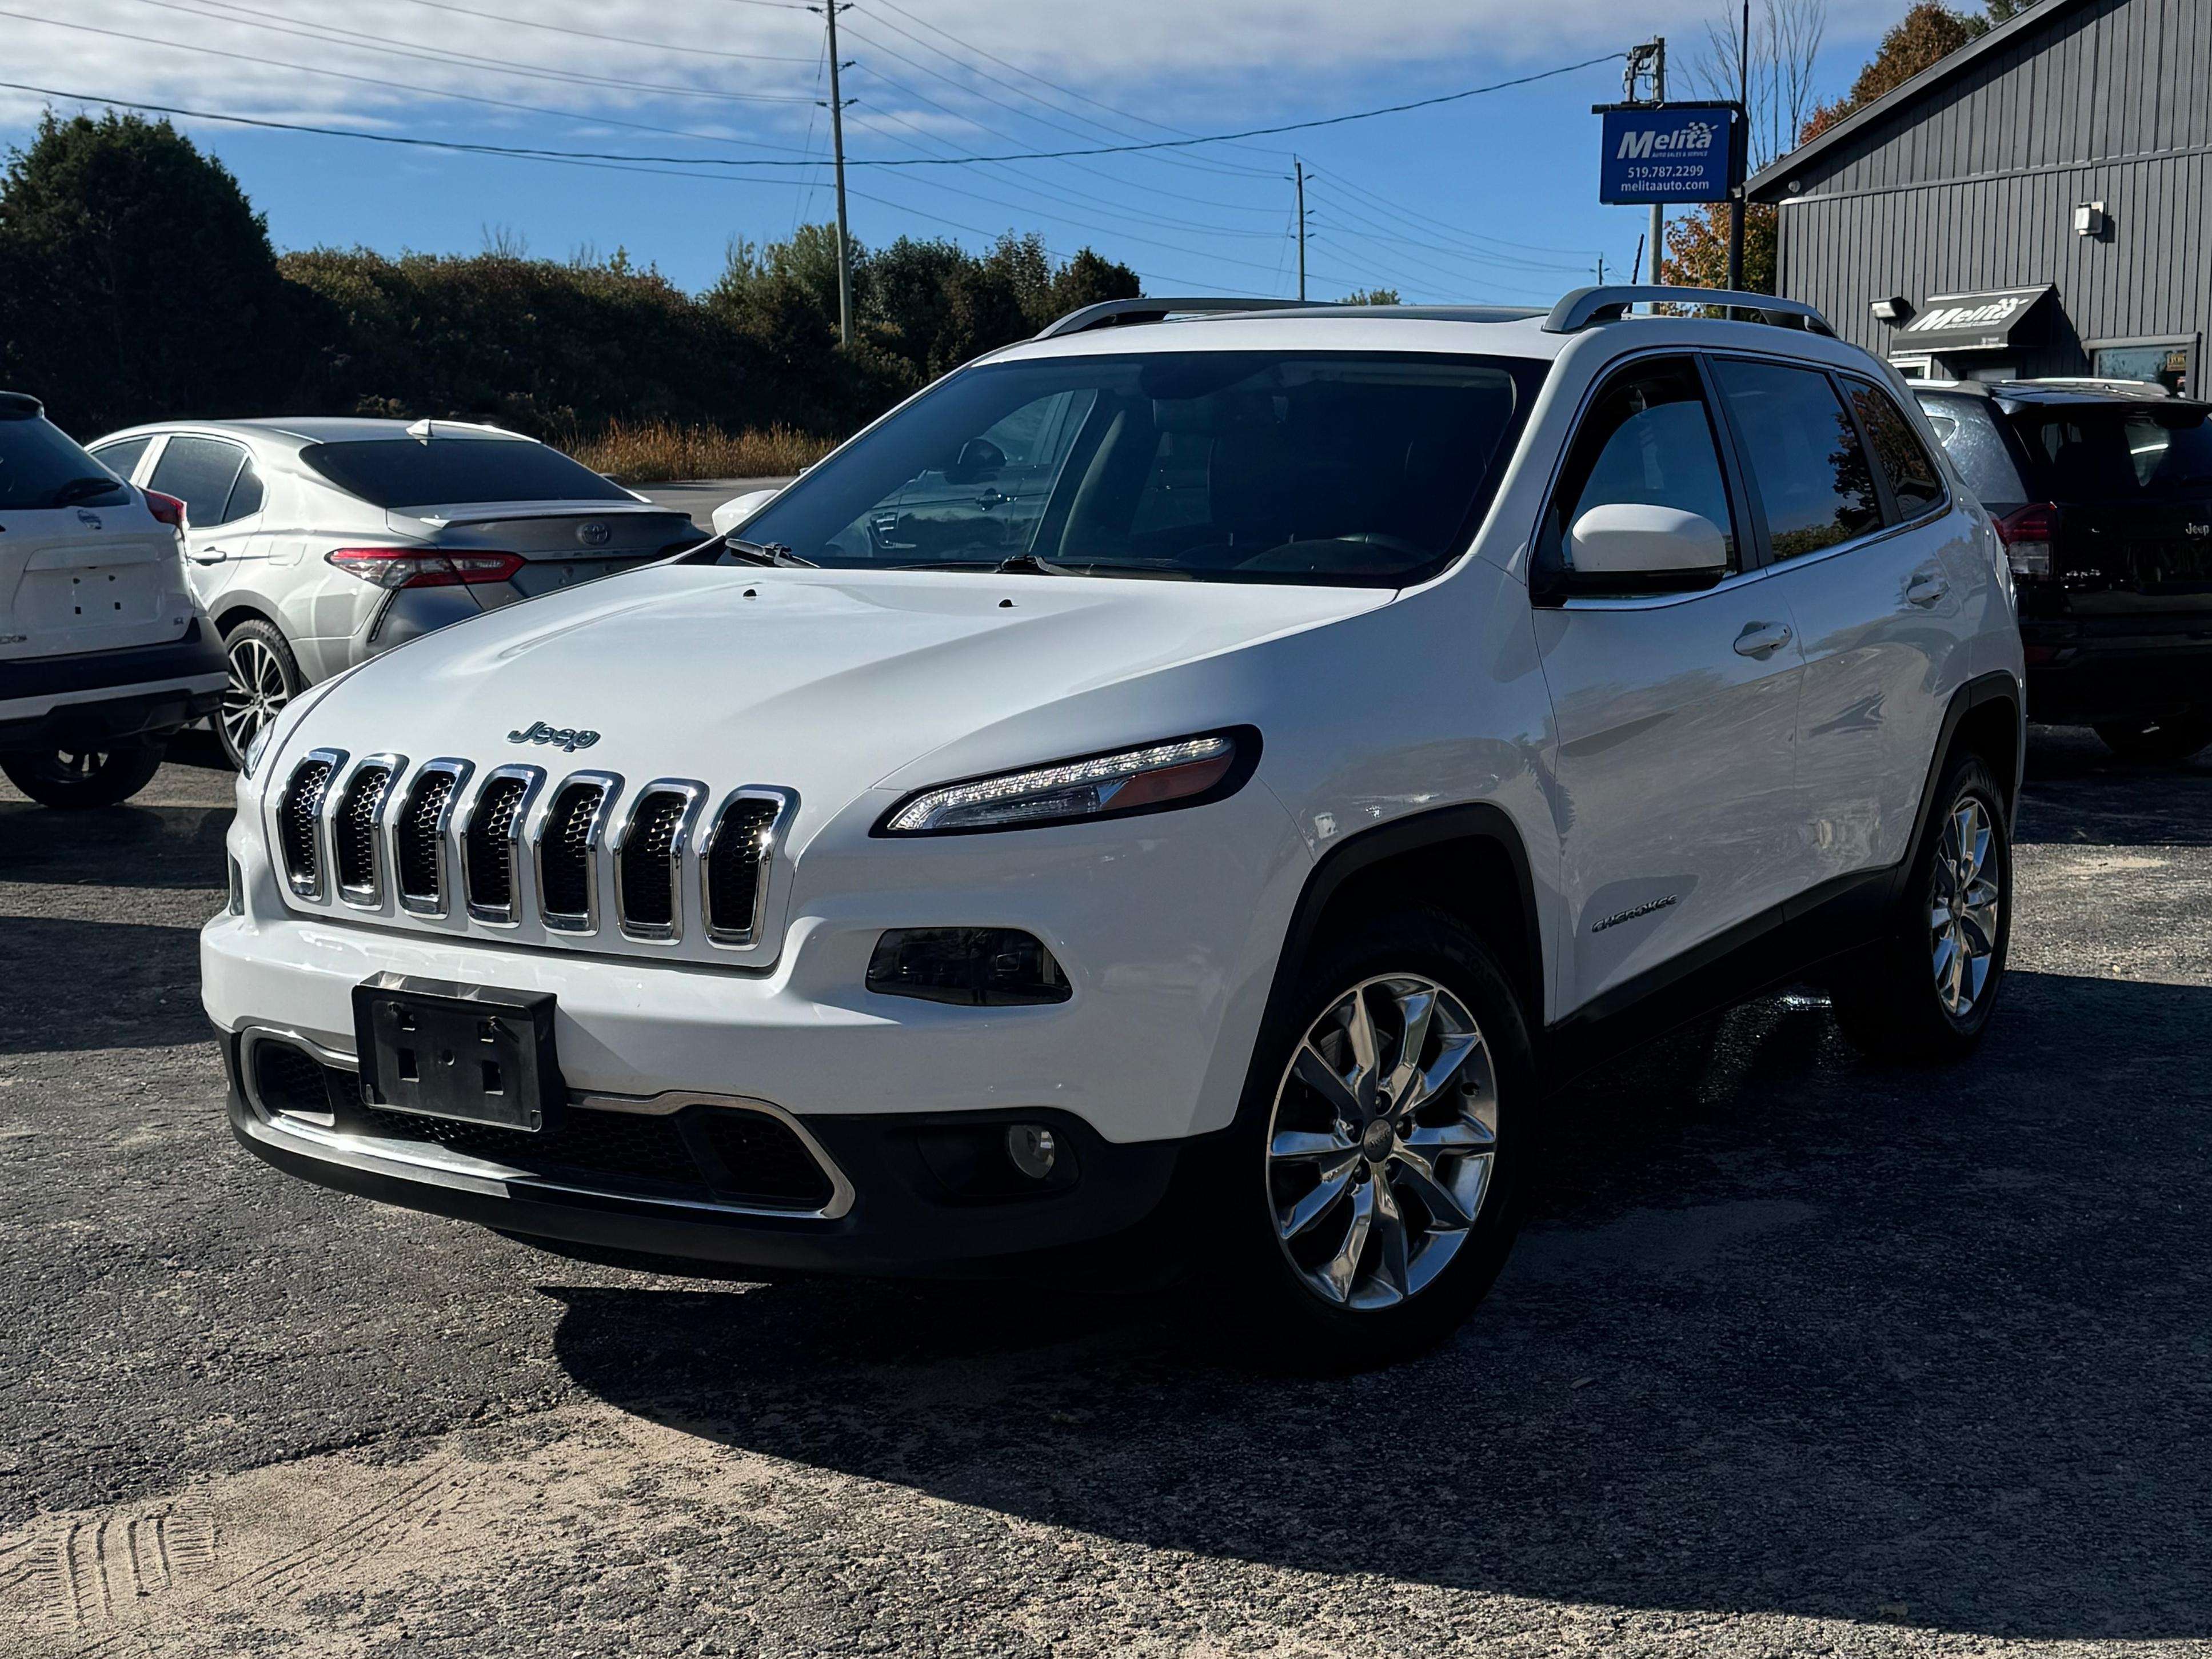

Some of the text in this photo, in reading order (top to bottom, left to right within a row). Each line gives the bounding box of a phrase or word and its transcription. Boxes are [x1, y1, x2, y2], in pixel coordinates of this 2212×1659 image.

[1616, 126, 1714, 159] Melita
[1628, 165, 1704, 178] 519.787.2299
[1621, 180, 1709, 192] melitaauto.com
[2185, 523, 2209, 536] Jeep
[507, 721, 601, 753] Jeep
